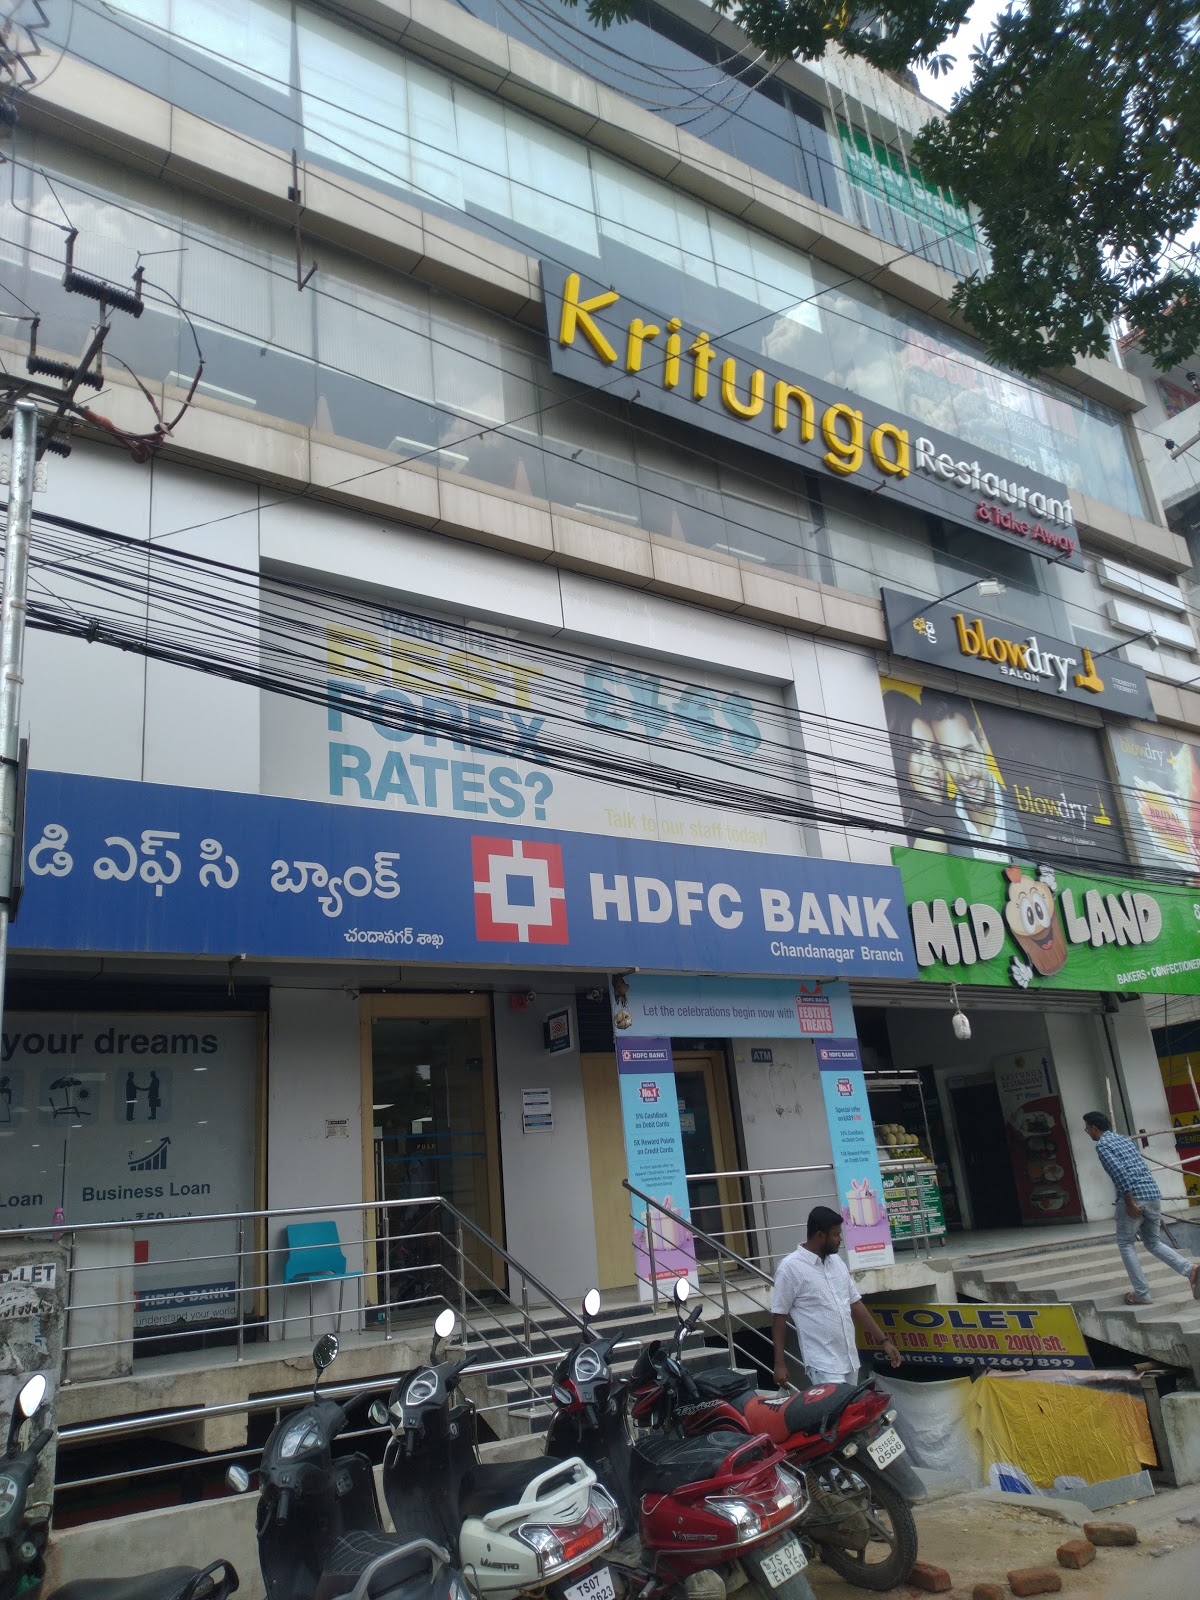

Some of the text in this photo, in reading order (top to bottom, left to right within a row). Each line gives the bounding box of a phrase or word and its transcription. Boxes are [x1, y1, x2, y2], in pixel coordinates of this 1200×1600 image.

[559, 272, 910, 478] Kritunga
[915, 436, 1073, 527] Restaurant
[1031, 522, 1077, 558] Away
[380, 610, 446, 643] WANT
[326, 623, 544, 708] BEST
[954, 613, 1071, 693] blowdry
[1000, 666, 1040, 683] SALON
[327, 678, 550, 763] FOREX
[1120, 737, 1164, 767] blowdry
[328, 741, 554, 822] RATES?
[1013, 784, 1088, 830] blowdry
[603, 808, 768, 848] Talk to our staff today!
[28, 823, 401, 918] డి ఎఫ్ సి బ్యాంక్
[589, 872, 900, 940] HDFC BANK
[1060, 888, 1162, 947] LAND
[770, 941, 904, 963] Chandanagar Branch
[1117, 969, 1147, 985] BAKERS
[643, 1005, 794, 1020] Let the celebrations begin now with
[799, 1007, 831, 1019] FESTIVE
[801, 1018, 832, 1031] TREATS
[1, 1028, 218, 1061] your dreams
[753, 1050, 771, 1061] ATM
[641, 1088, 657, 1097] No.1
[82, 1185, 164, 1202] Business
[169, 1182, 211, 1197] Loan
[144, 1286, 230, 1307] HDFC BANK
[136, 1306, 236, 1326] understand your world
[864, 1332, 898, 1347] RT
[900, 1332, 929, 1349] FOR
[933, 1332, 949, 1348] 4th
[952, 1333, 1000, 1350] FLOOR
[1005, 1334, 1042, 1352] 2000
[873, 1352, 1075, 1368] Cotact: 9912667899
[875, 1435, 896, 1454] TS15EG
[877, 1441, 902, 1464] 0566
[769, 1543, 796, 1568] TS 07
[772, 1557, 807, 1583] EV6150
[576, 1575, 601, 1597] TS07
